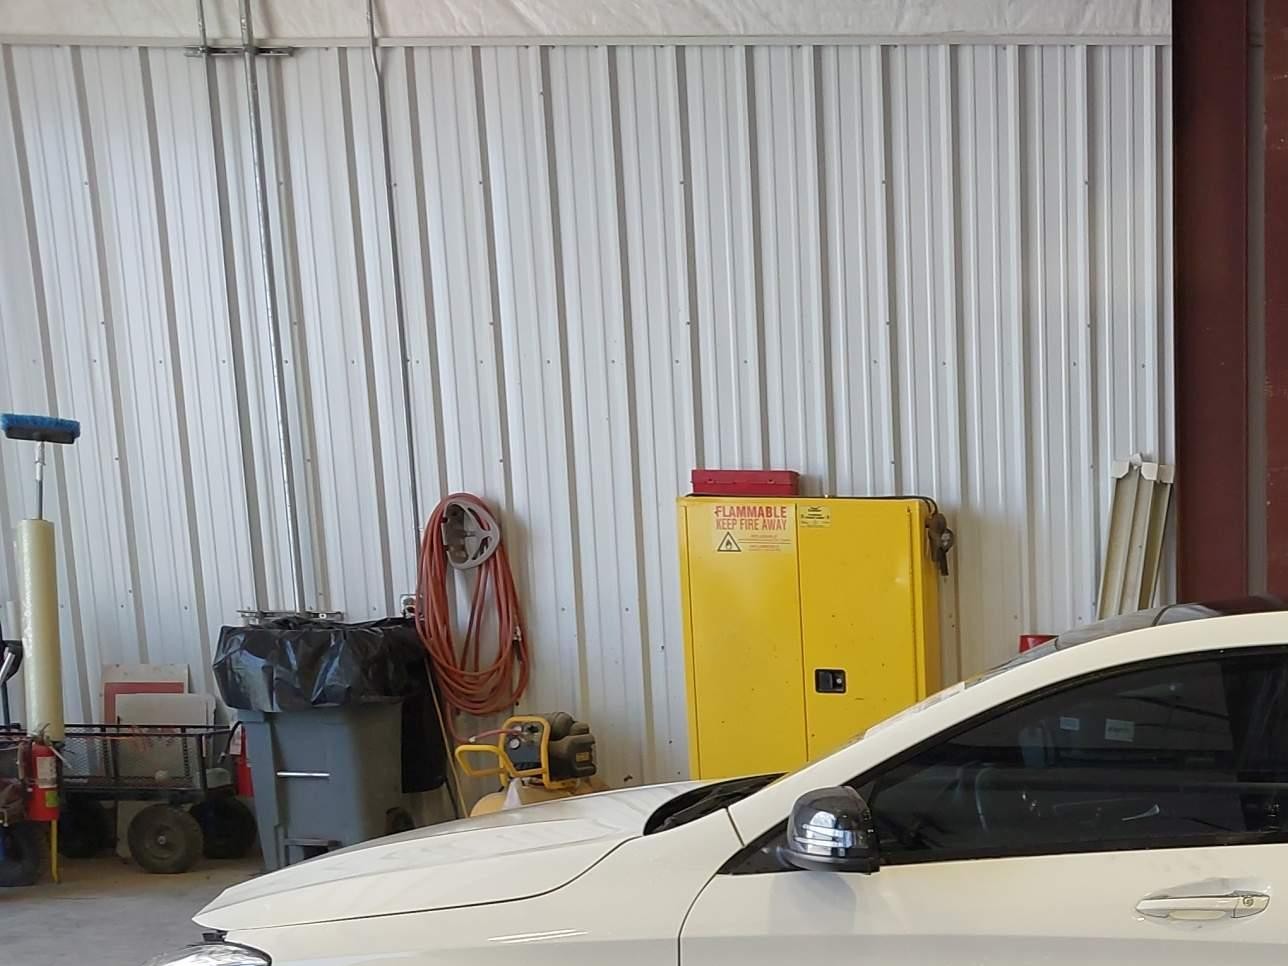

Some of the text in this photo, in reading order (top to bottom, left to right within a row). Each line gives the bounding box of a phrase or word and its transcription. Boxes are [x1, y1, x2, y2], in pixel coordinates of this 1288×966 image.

[716, 505, 787, 518] FLAMMABLE
[716, 519, 787, 531] KEEP FIRE AWAY
